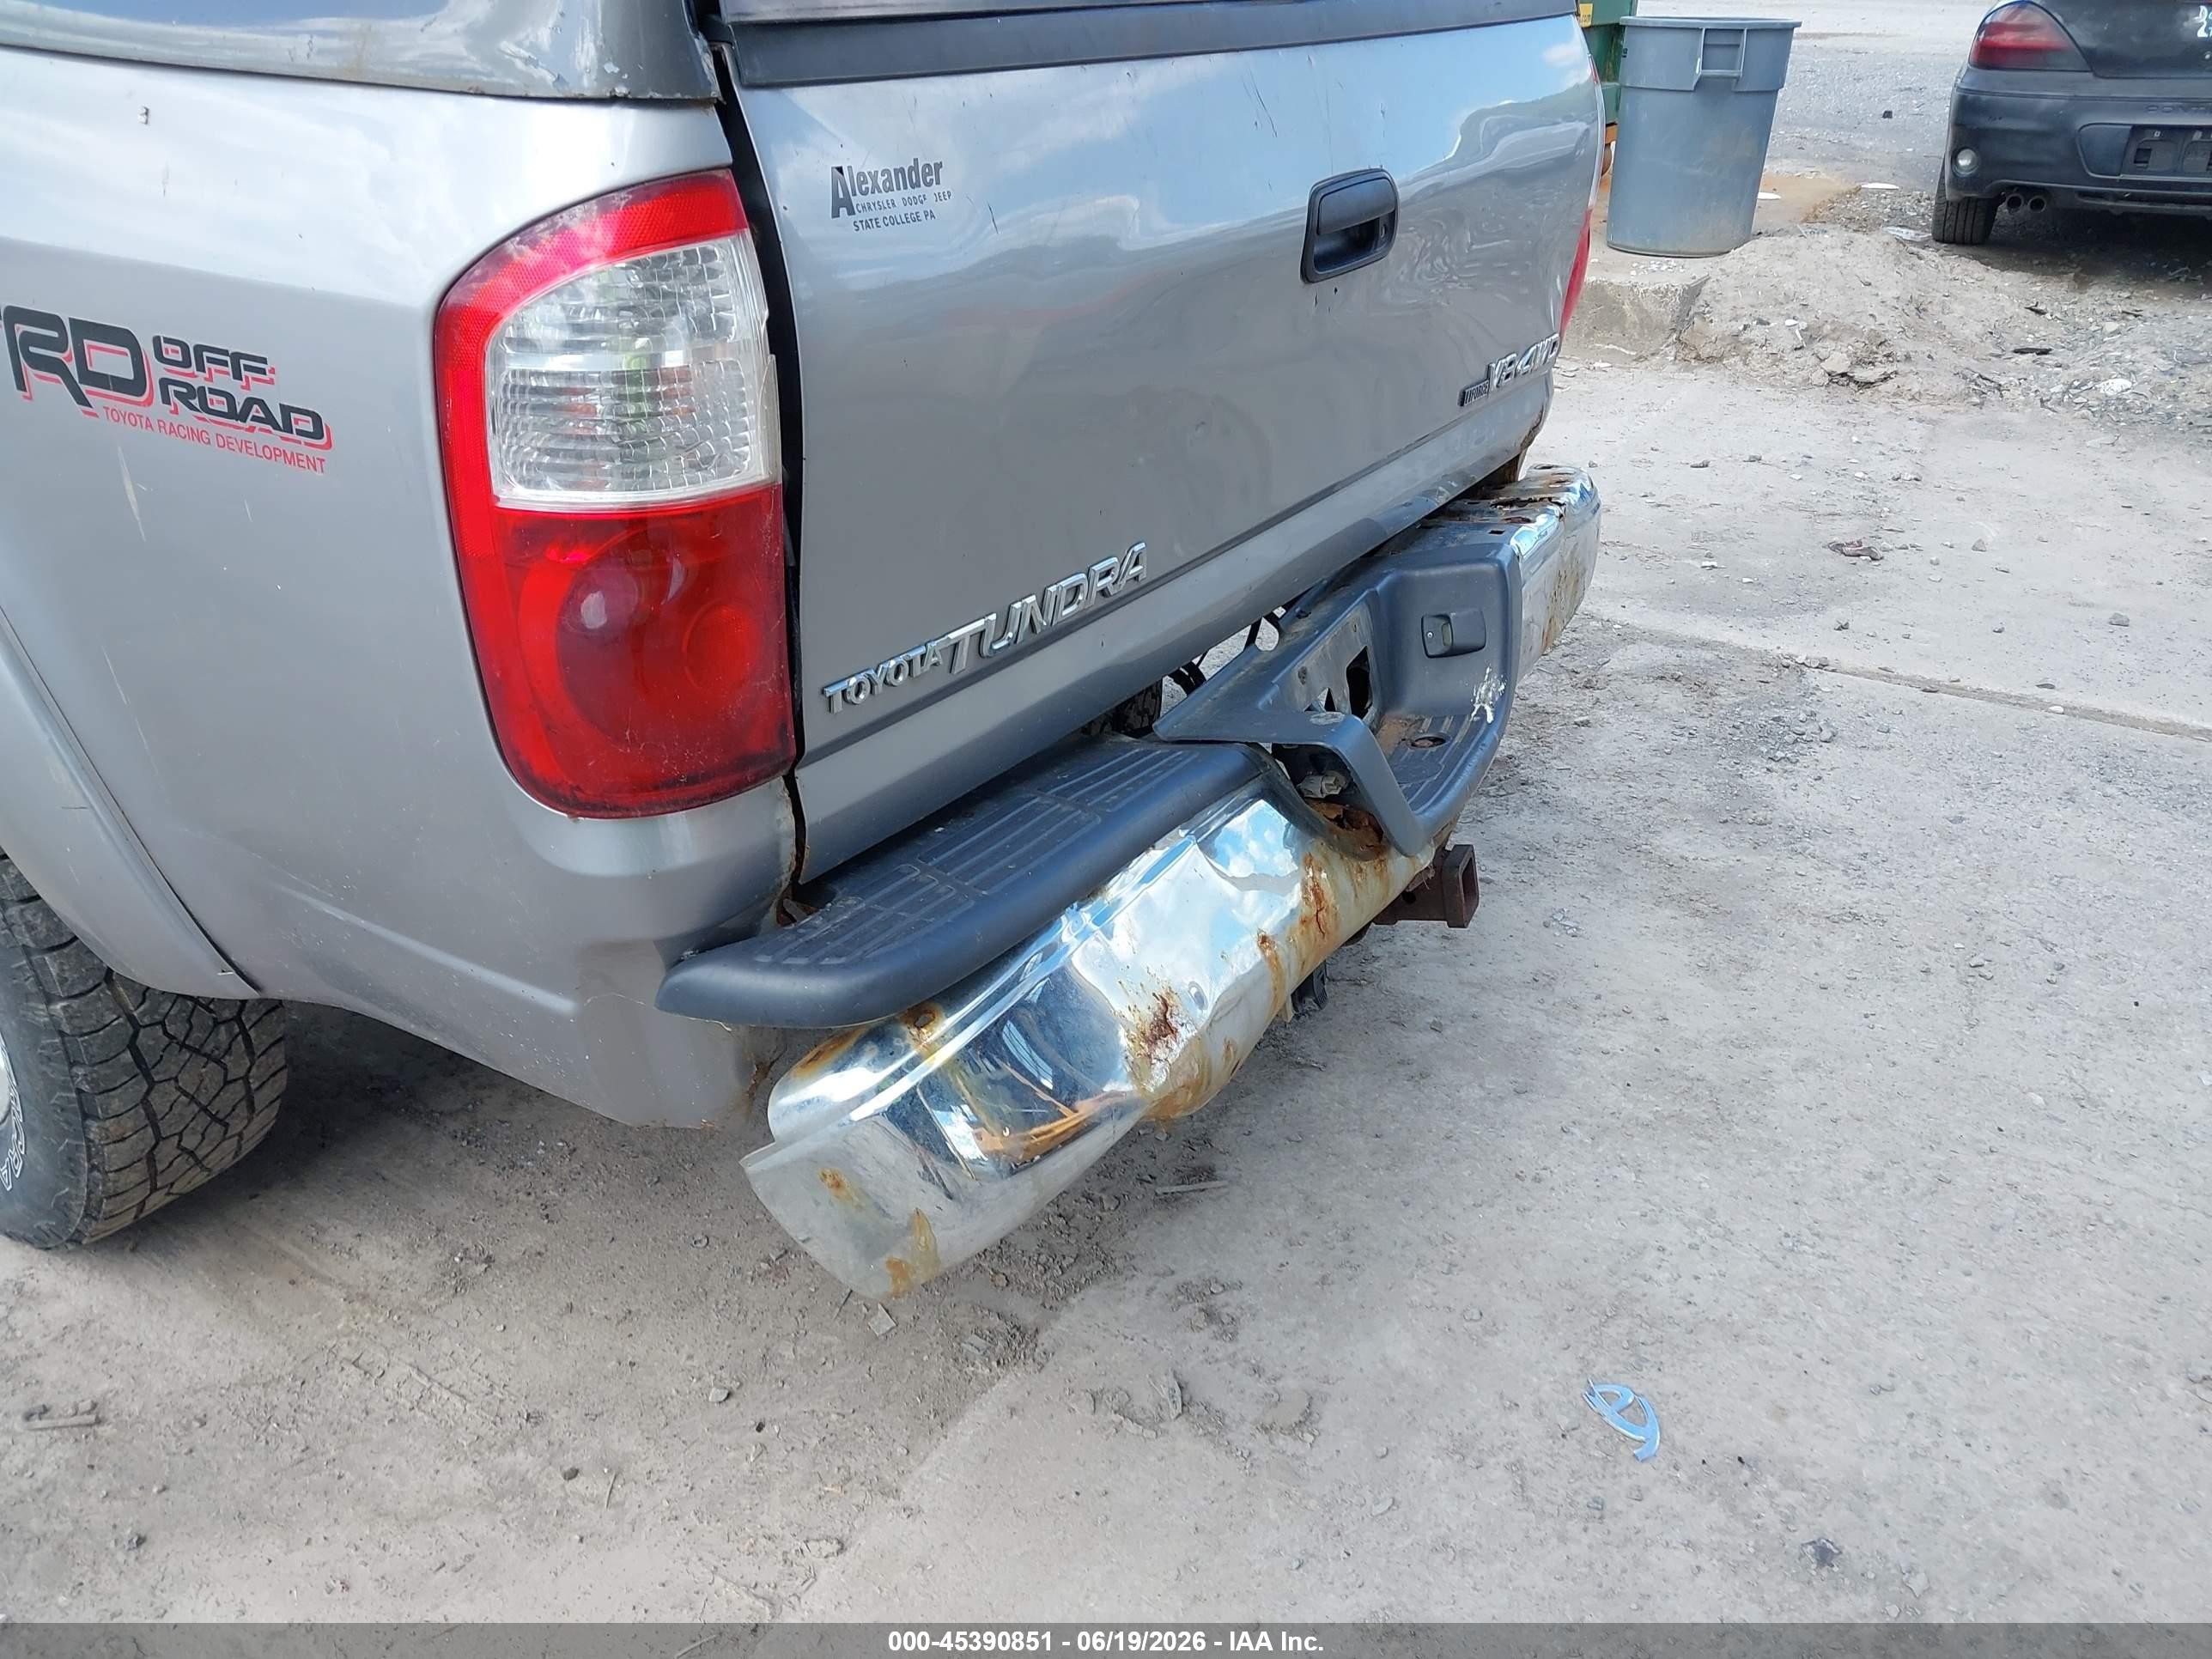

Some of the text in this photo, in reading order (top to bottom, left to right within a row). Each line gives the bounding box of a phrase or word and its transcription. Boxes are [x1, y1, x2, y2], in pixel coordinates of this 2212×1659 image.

[830, 158, 943, 219] Alexander
[853, 209, 937, 232] STATE COLLEGE PA
[855, 198, 896, 214] CHRYSLER
[934, 190, 952, 203] JEEP
[0, 305, 155, 418] RD
[152, 335, 275, 391] OFF
[103, 405, 326, 474] TOYOTA RACING DEVELOPMENT
[158, 377, 333, 450] ROAD
[822, 541, 1148, 714] TOYOTA TUNDRA
